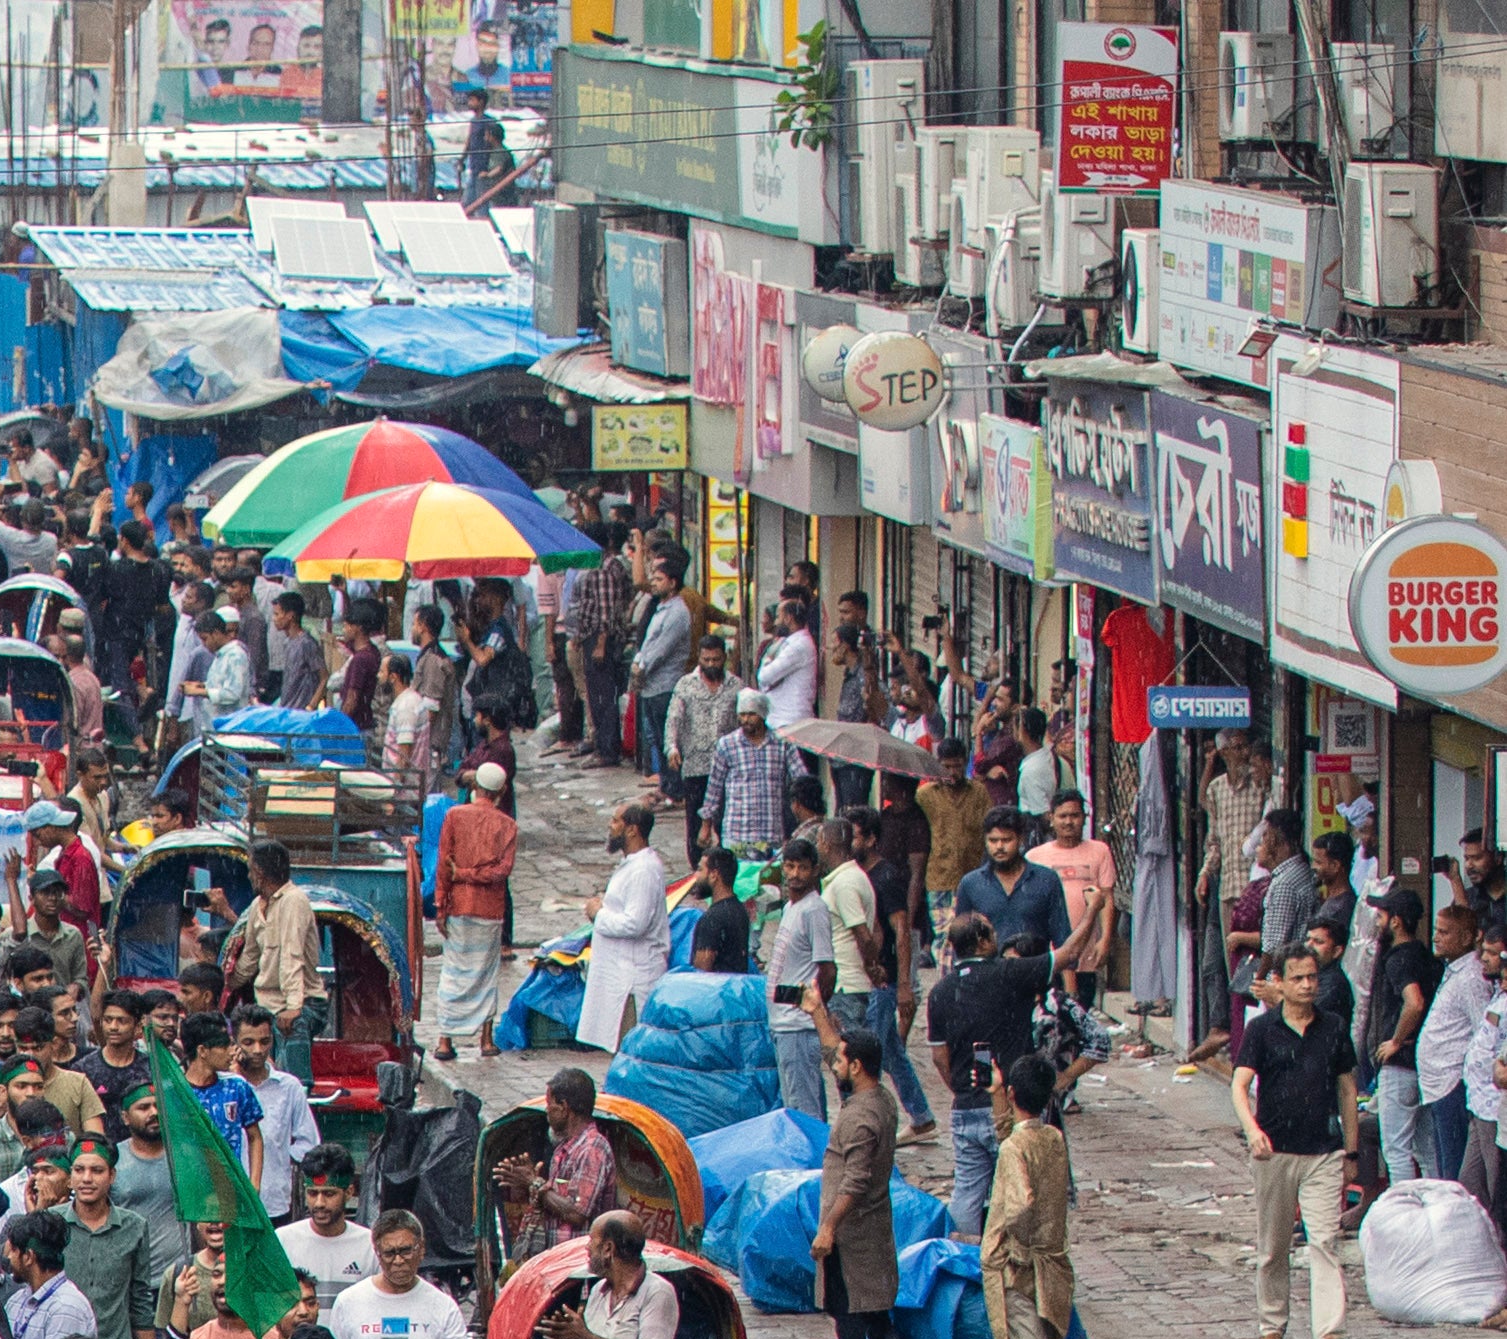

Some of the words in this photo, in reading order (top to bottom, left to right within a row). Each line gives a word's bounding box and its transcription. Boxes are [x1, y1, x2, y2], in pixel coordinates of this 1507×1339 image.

[1071, 103, 1100, 121] এই
[1106, 104, 1158, 121] শাখায়
[1069, 124, 1118, 140] লকার
[1123, 126, 1166, 144] ভাড়া
[1070, 144, 1124, 161] দেওয়া
[853, 355, 937, 413] STEP
[1155, 415, 1232, 573] চেরী
[1389, 581, 1498, 605] BURGER
[1389, 607, 1499, 644] KING
[1171, 698, 1250, 718] পেগাসাস
